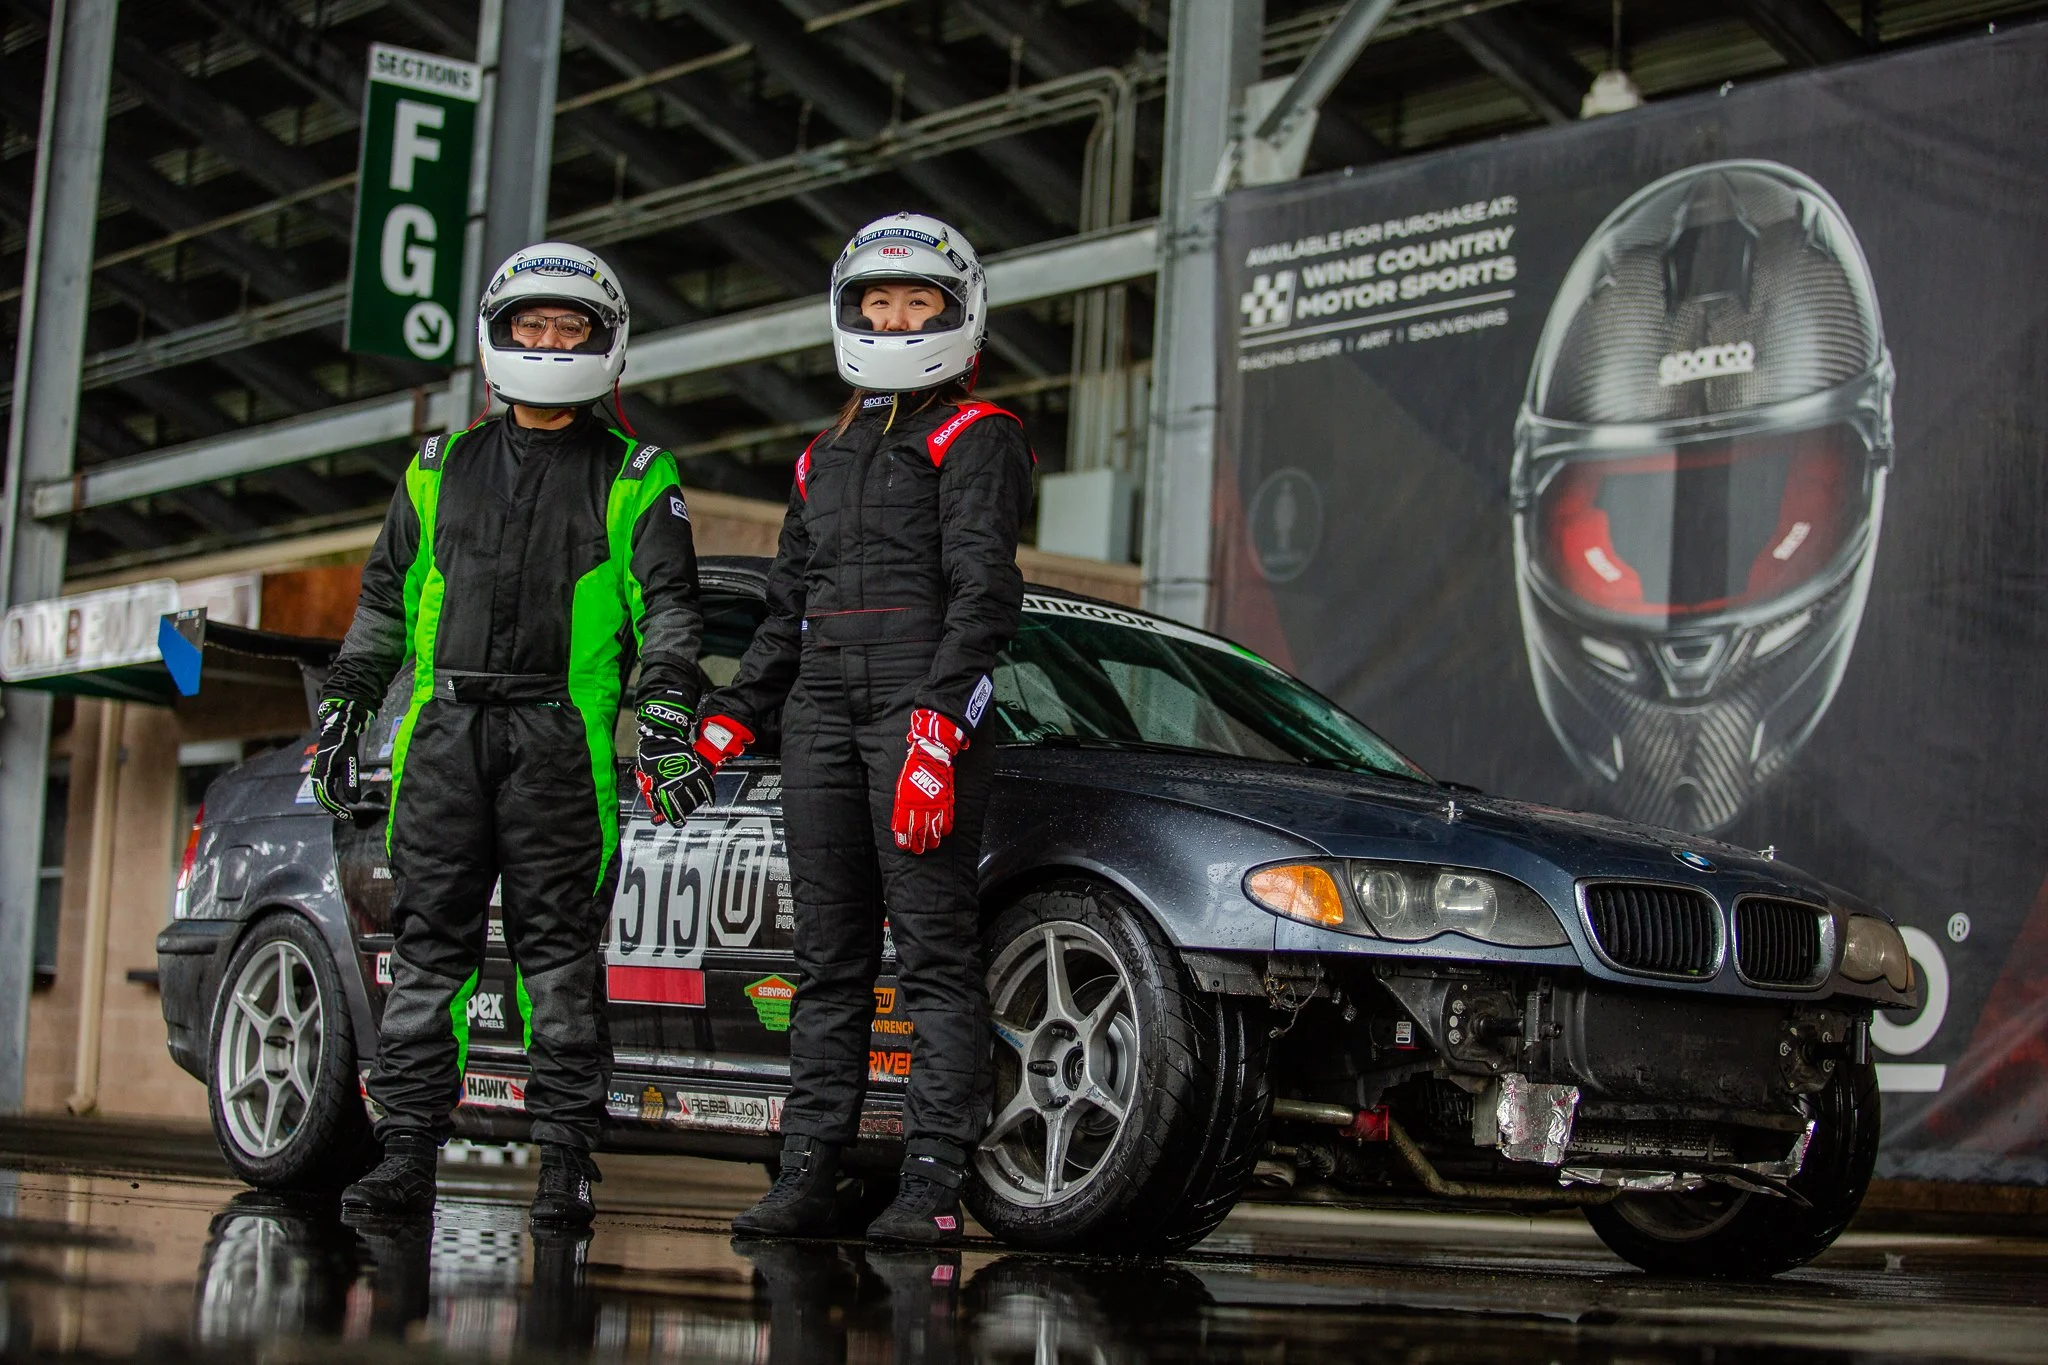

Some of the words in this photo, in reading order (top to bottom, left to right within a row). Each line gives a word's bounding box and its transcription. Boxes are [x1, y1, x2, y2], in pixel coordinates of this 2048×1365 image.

[376, 53, 472, 90] SECTIONS
[389, 98, 445, 192] F
[857, 230, 883, 245] LUCKY
[884, 229, 901, 237] DOG
[903, 229, 935, 244] RACING
[882, 247, 909, 255] BELL
[1245, 230, 1343, 268] AVAILABLE
[1343, 223, 1383, 249] FOR
[1383, 201, 1489, 241] PURCHASE
[380, 204, 437, 299] G
[516, 258, 543, 271] LUCKY
[543, 257, 561, 266] DOG
[562, 258, 592, 275] RACING
[1302, 253, 1377, 289] WINE
[1377, 224, 1516, 275] COUNTRY
[1297, 279, 1398, 319] MOTOR
[1399, 255, 1517, 300] SPORTS
[1356, 329, 1394, 351] ART
[1408, 307, 1509, 342] SOUVENIRS
[934, 409, 980, 446] sparco
[348, 756, 357, 787] sparco
[911, 770, 941, 796] OMP
[758, 986, 793, 998] SERVPRO
[467, 992, 504, 1027] pex
[478, 1019, 505, 1029] WHEELS
[872, 1020, 914, 1035] WRENCH
[466, 1077, 509, 1100] HAWK
